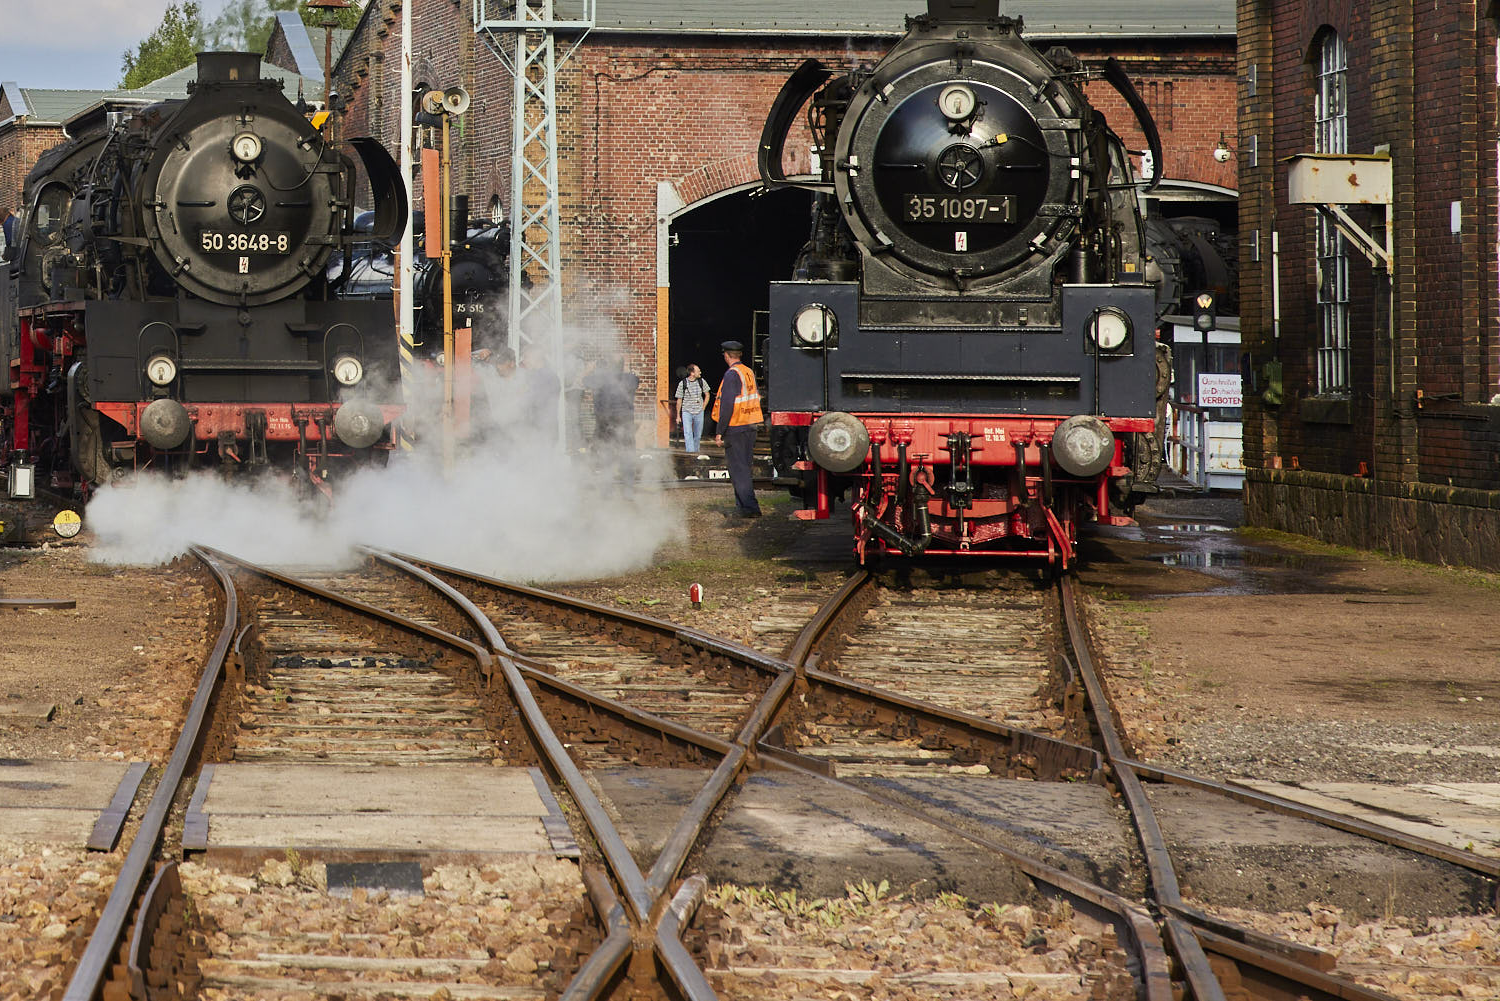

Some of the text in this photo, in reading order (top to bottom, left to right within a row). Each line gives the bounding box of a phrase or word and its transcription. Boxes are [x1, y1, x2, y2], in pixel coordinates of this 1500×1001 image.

[909, 198, 1010, 219] 35 1097-1
[202, 233, 288, 251] 50 3648-8
[456, 304, 466, 313] 75
[1202, 396, 1242, 404] VERBOTEN
